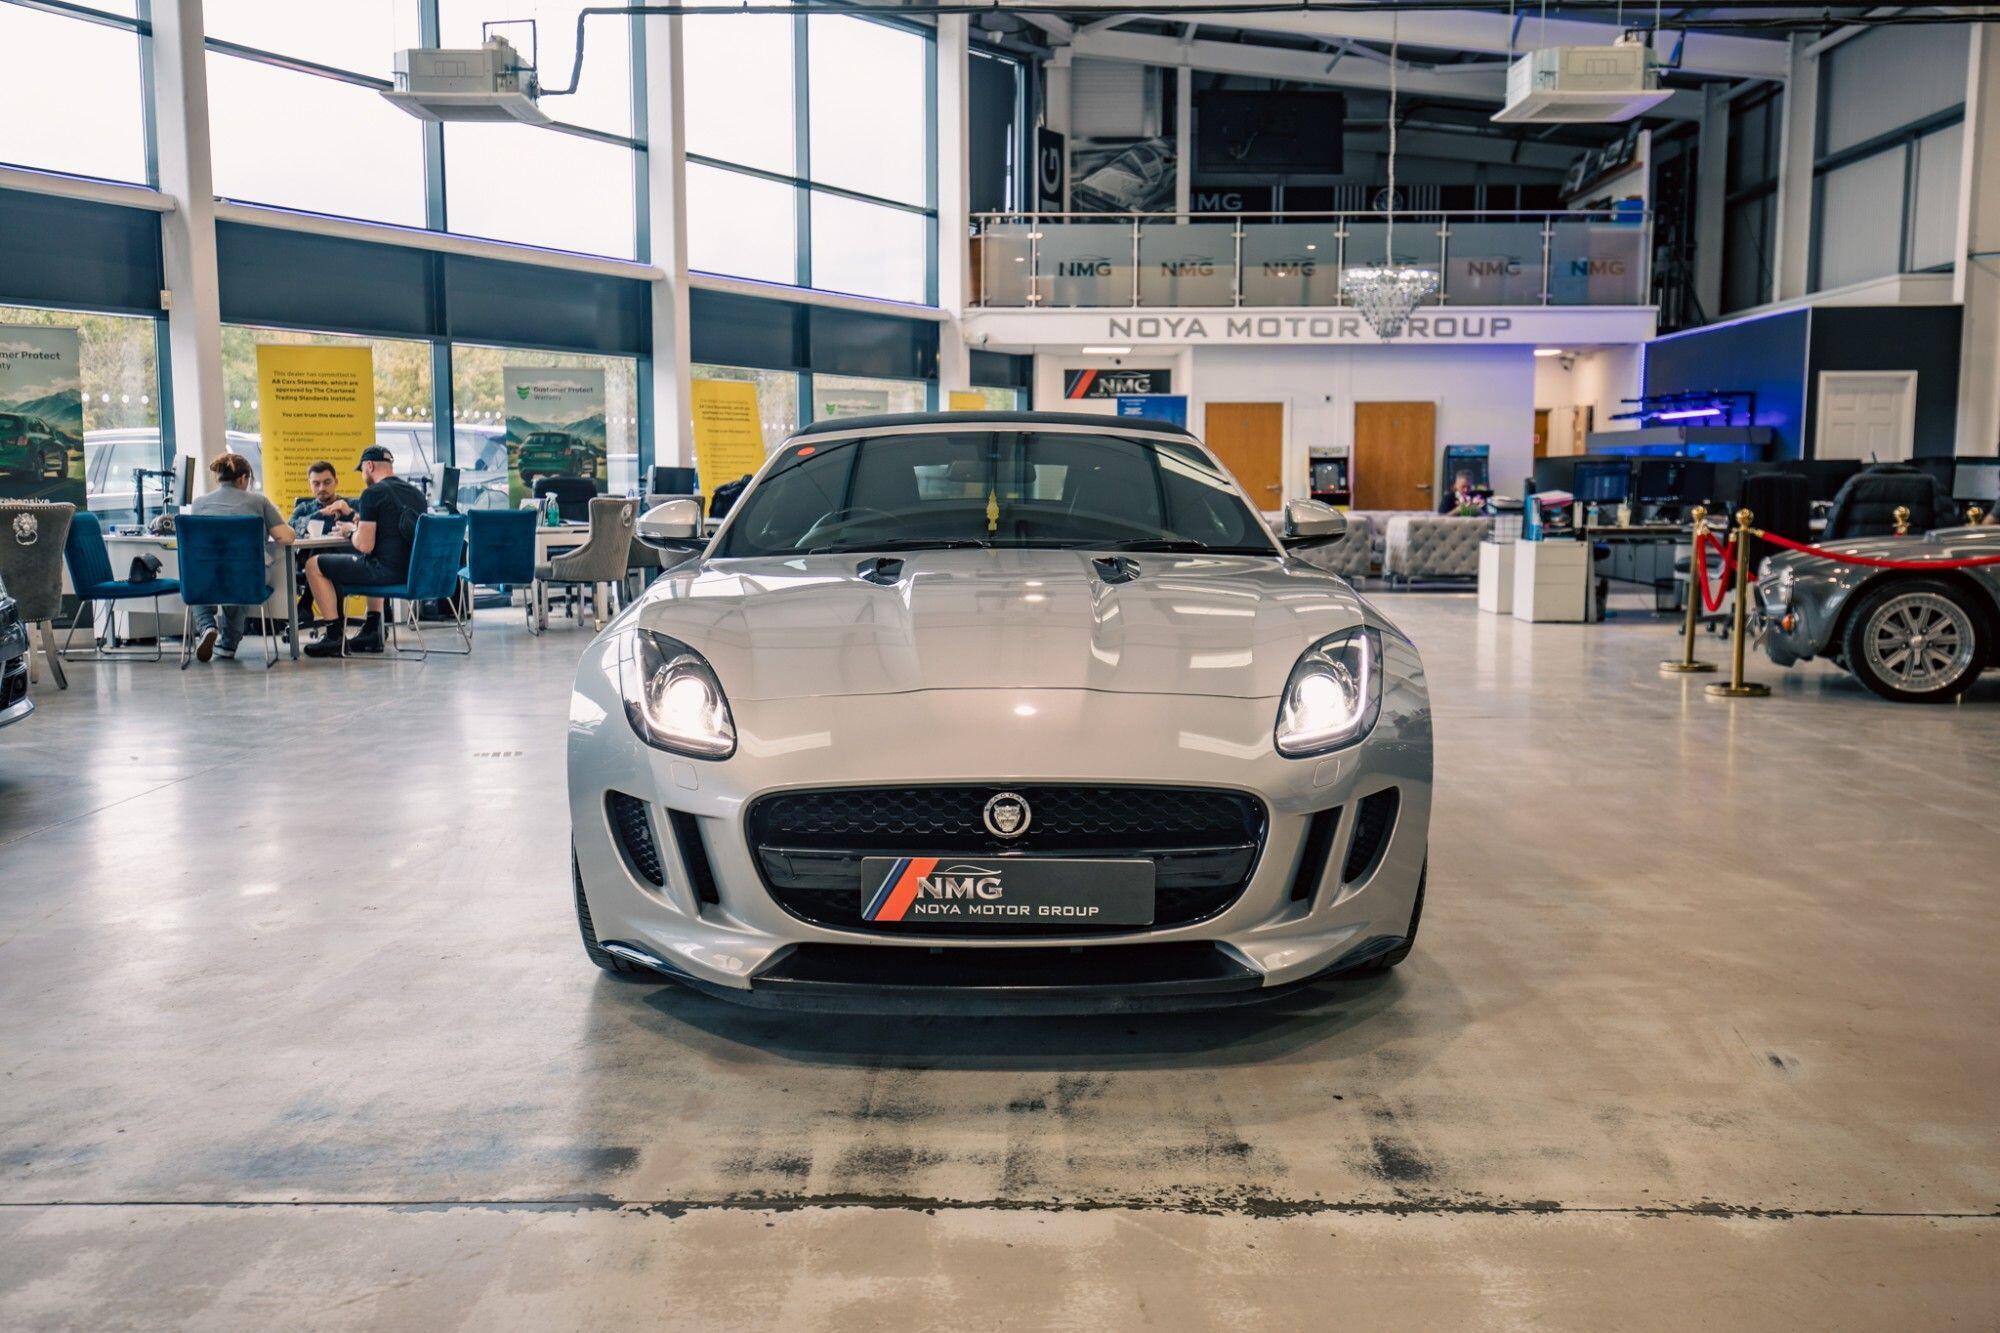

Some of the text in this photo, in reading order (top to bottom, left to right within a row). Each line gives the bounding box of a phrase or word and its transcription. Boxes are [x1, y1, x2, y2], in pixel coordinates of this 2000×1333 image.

[1161, 262, 1215, 277] NMG
[1263, 262, 1316, 277] NMG
[1468, 261, 1522, 276] NMG
[1571, 261, 1625, 276] NMG
[1109, 317, 1208, 338] NOYA
[1227, 317, 1360, 338] MOTOR
[22, 351, 61, 360] Protect
[1100, 378, 1151, 393] NMG
[916, 876, 1003, 900] NMG
[915, 904, 1100, 917] NOYA MOTOR GROUP
